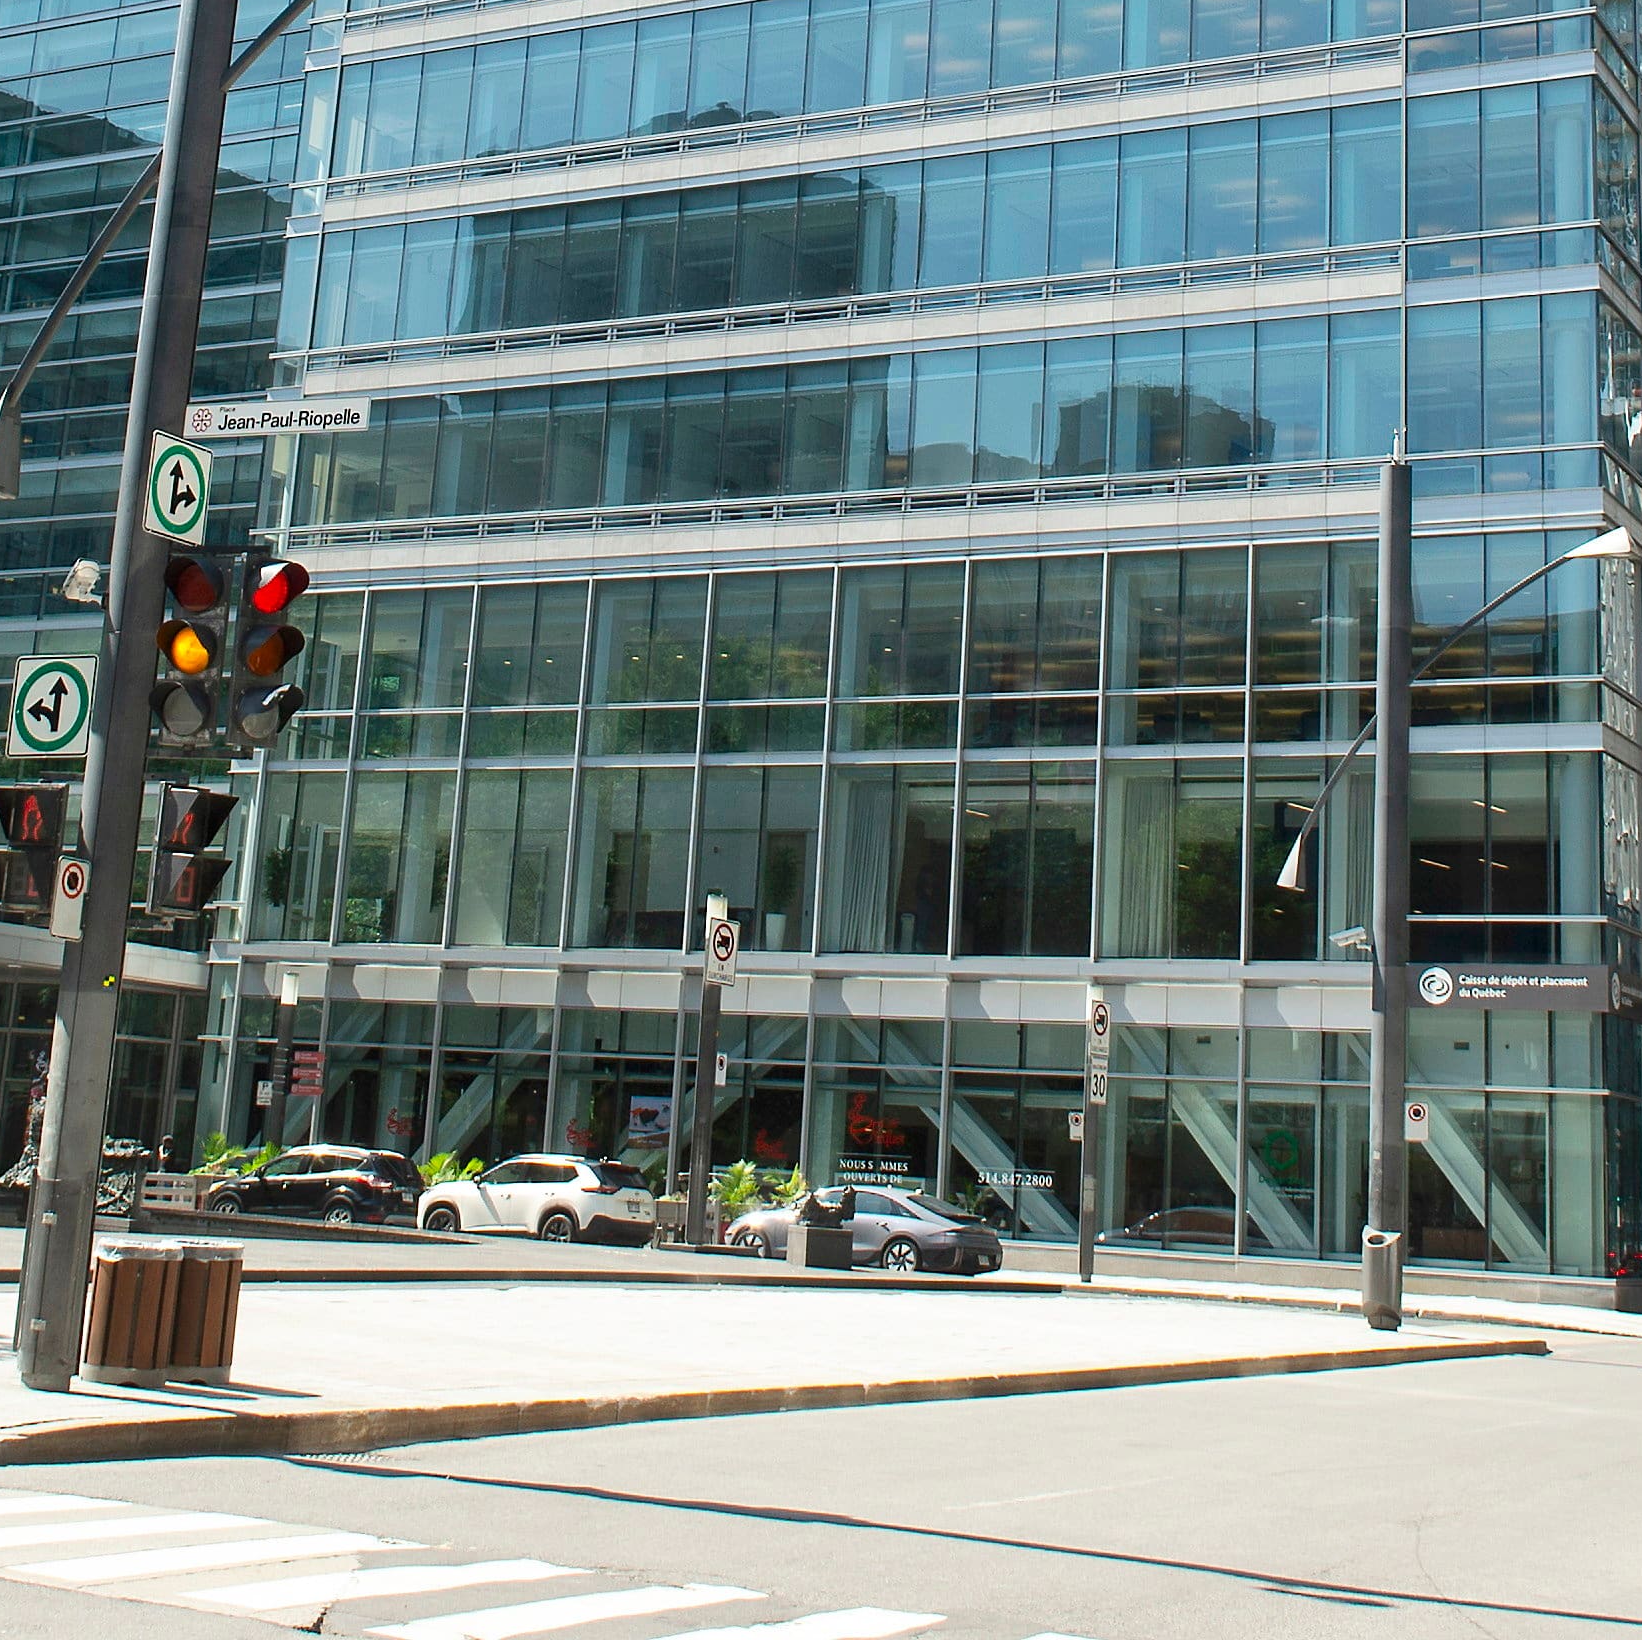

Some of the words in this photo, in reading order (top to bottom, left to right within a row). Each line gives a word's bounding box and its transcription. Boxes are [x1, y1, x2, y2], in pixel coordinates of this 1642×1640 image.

[218, 409, 361, 431] Jean-Paul-Riopelle
[1458, 974, 1487, 985] Caisse
[1487, 974, 1500, 985] de
[1501, 974, 1528, 988] dépôt
[1528, 976, 1539, 986] et
[1539, 975, 1589, 988] placement
[1458, 987, 1471, 998] du
[1471, 987, 1507, 999] Québec
[1092, 1074, 1106, 1097] 30
